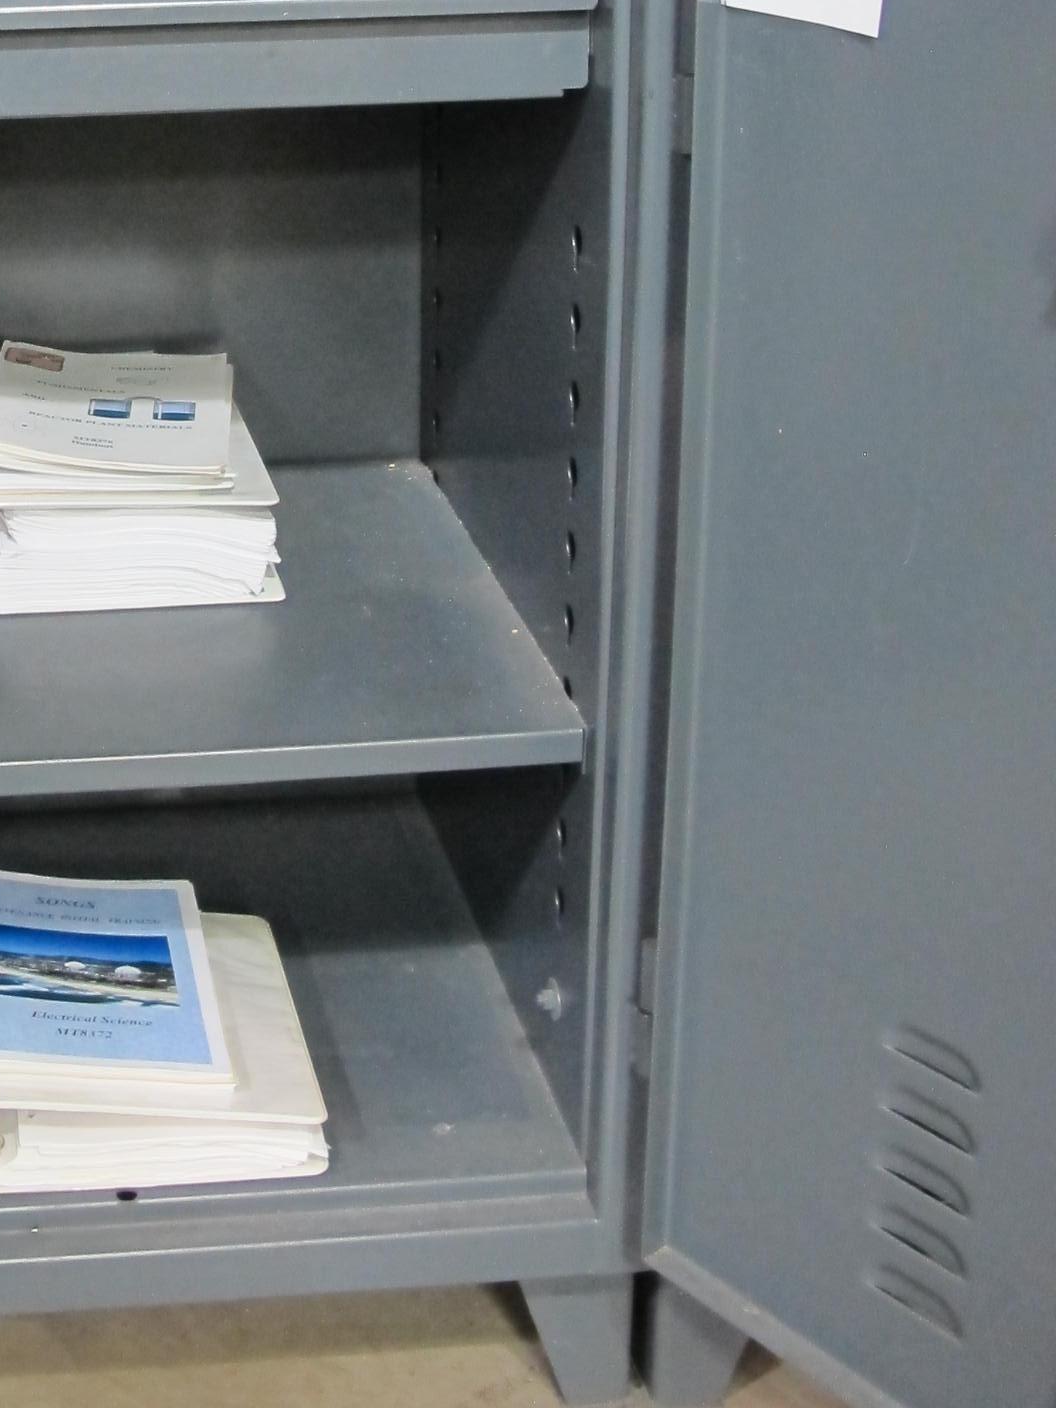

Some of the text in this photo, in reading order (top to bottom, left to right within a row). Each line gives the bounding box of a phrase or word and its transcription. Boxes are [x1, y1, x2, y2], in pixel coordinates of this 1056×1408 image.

[35, 895, 97, 910] SONGS
[32, 1010, 153, 1027] Electrical Science
